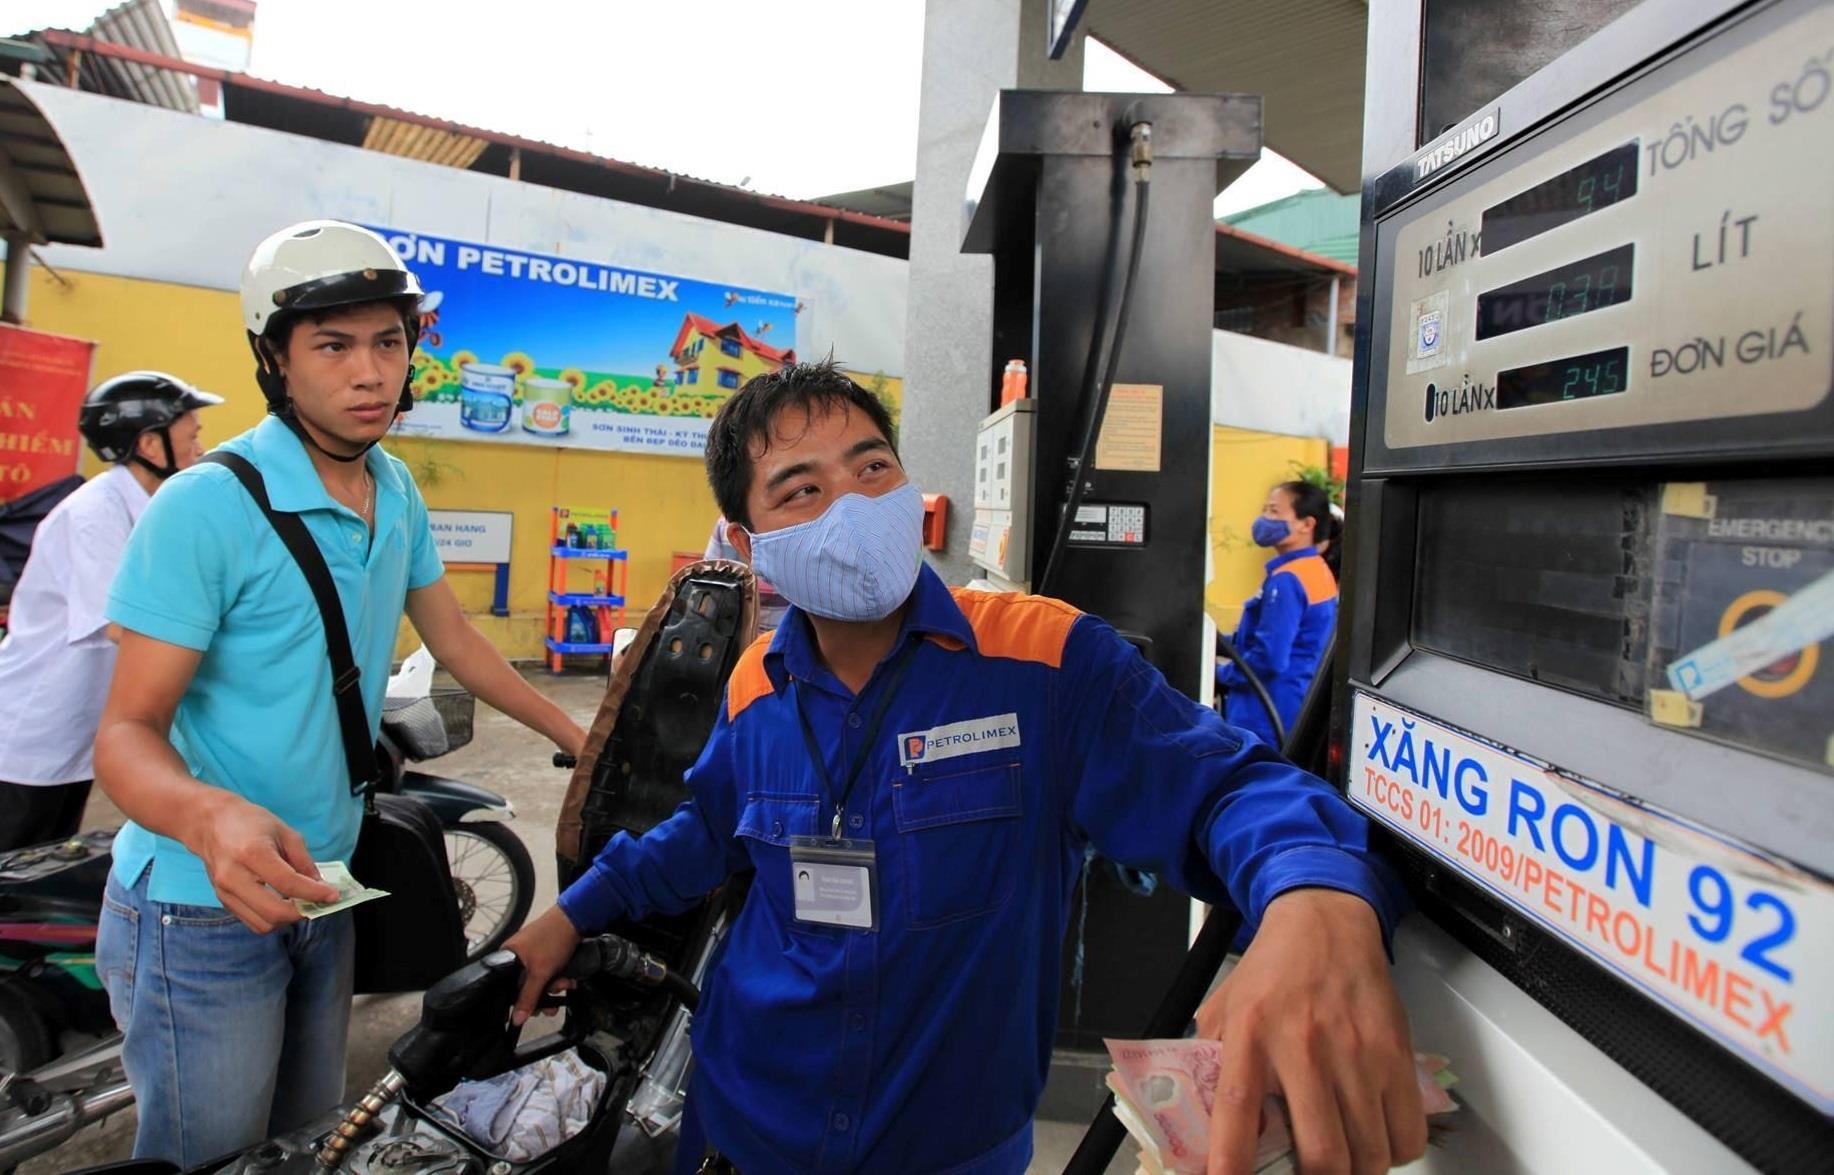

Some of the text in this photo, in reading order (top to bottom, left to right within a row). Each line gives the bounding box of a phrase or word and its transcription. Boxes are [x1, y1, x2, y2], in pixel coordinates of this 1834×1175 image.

[1417, 115, 1495, 178] TATSUNO
[1646, 103, 1750, 177] TỔNG
[384, 233, 679, 302] ƠN PETROLIMEX
[1418, 246, 1433, 279] 10
[1692, 210, 1759, 271] LÍT
[1649, 310, 1810, 378] ĐƠN GIÁ
[1435, 390, 1449, 417] 10
[1563, 360, 1619, 400] 245
[616, 425, 641, 434] SINH
[1741, 546, 1802, 569] STOP
[926, 726, 1017, 750] PETROLIMEX
[1368, 714, 1797, 986] XĂNG RON 92
[1364, 766, 1413, 821] TCCS
[1456, 821, 1793, 1054] 2009/PETROLIMEX
